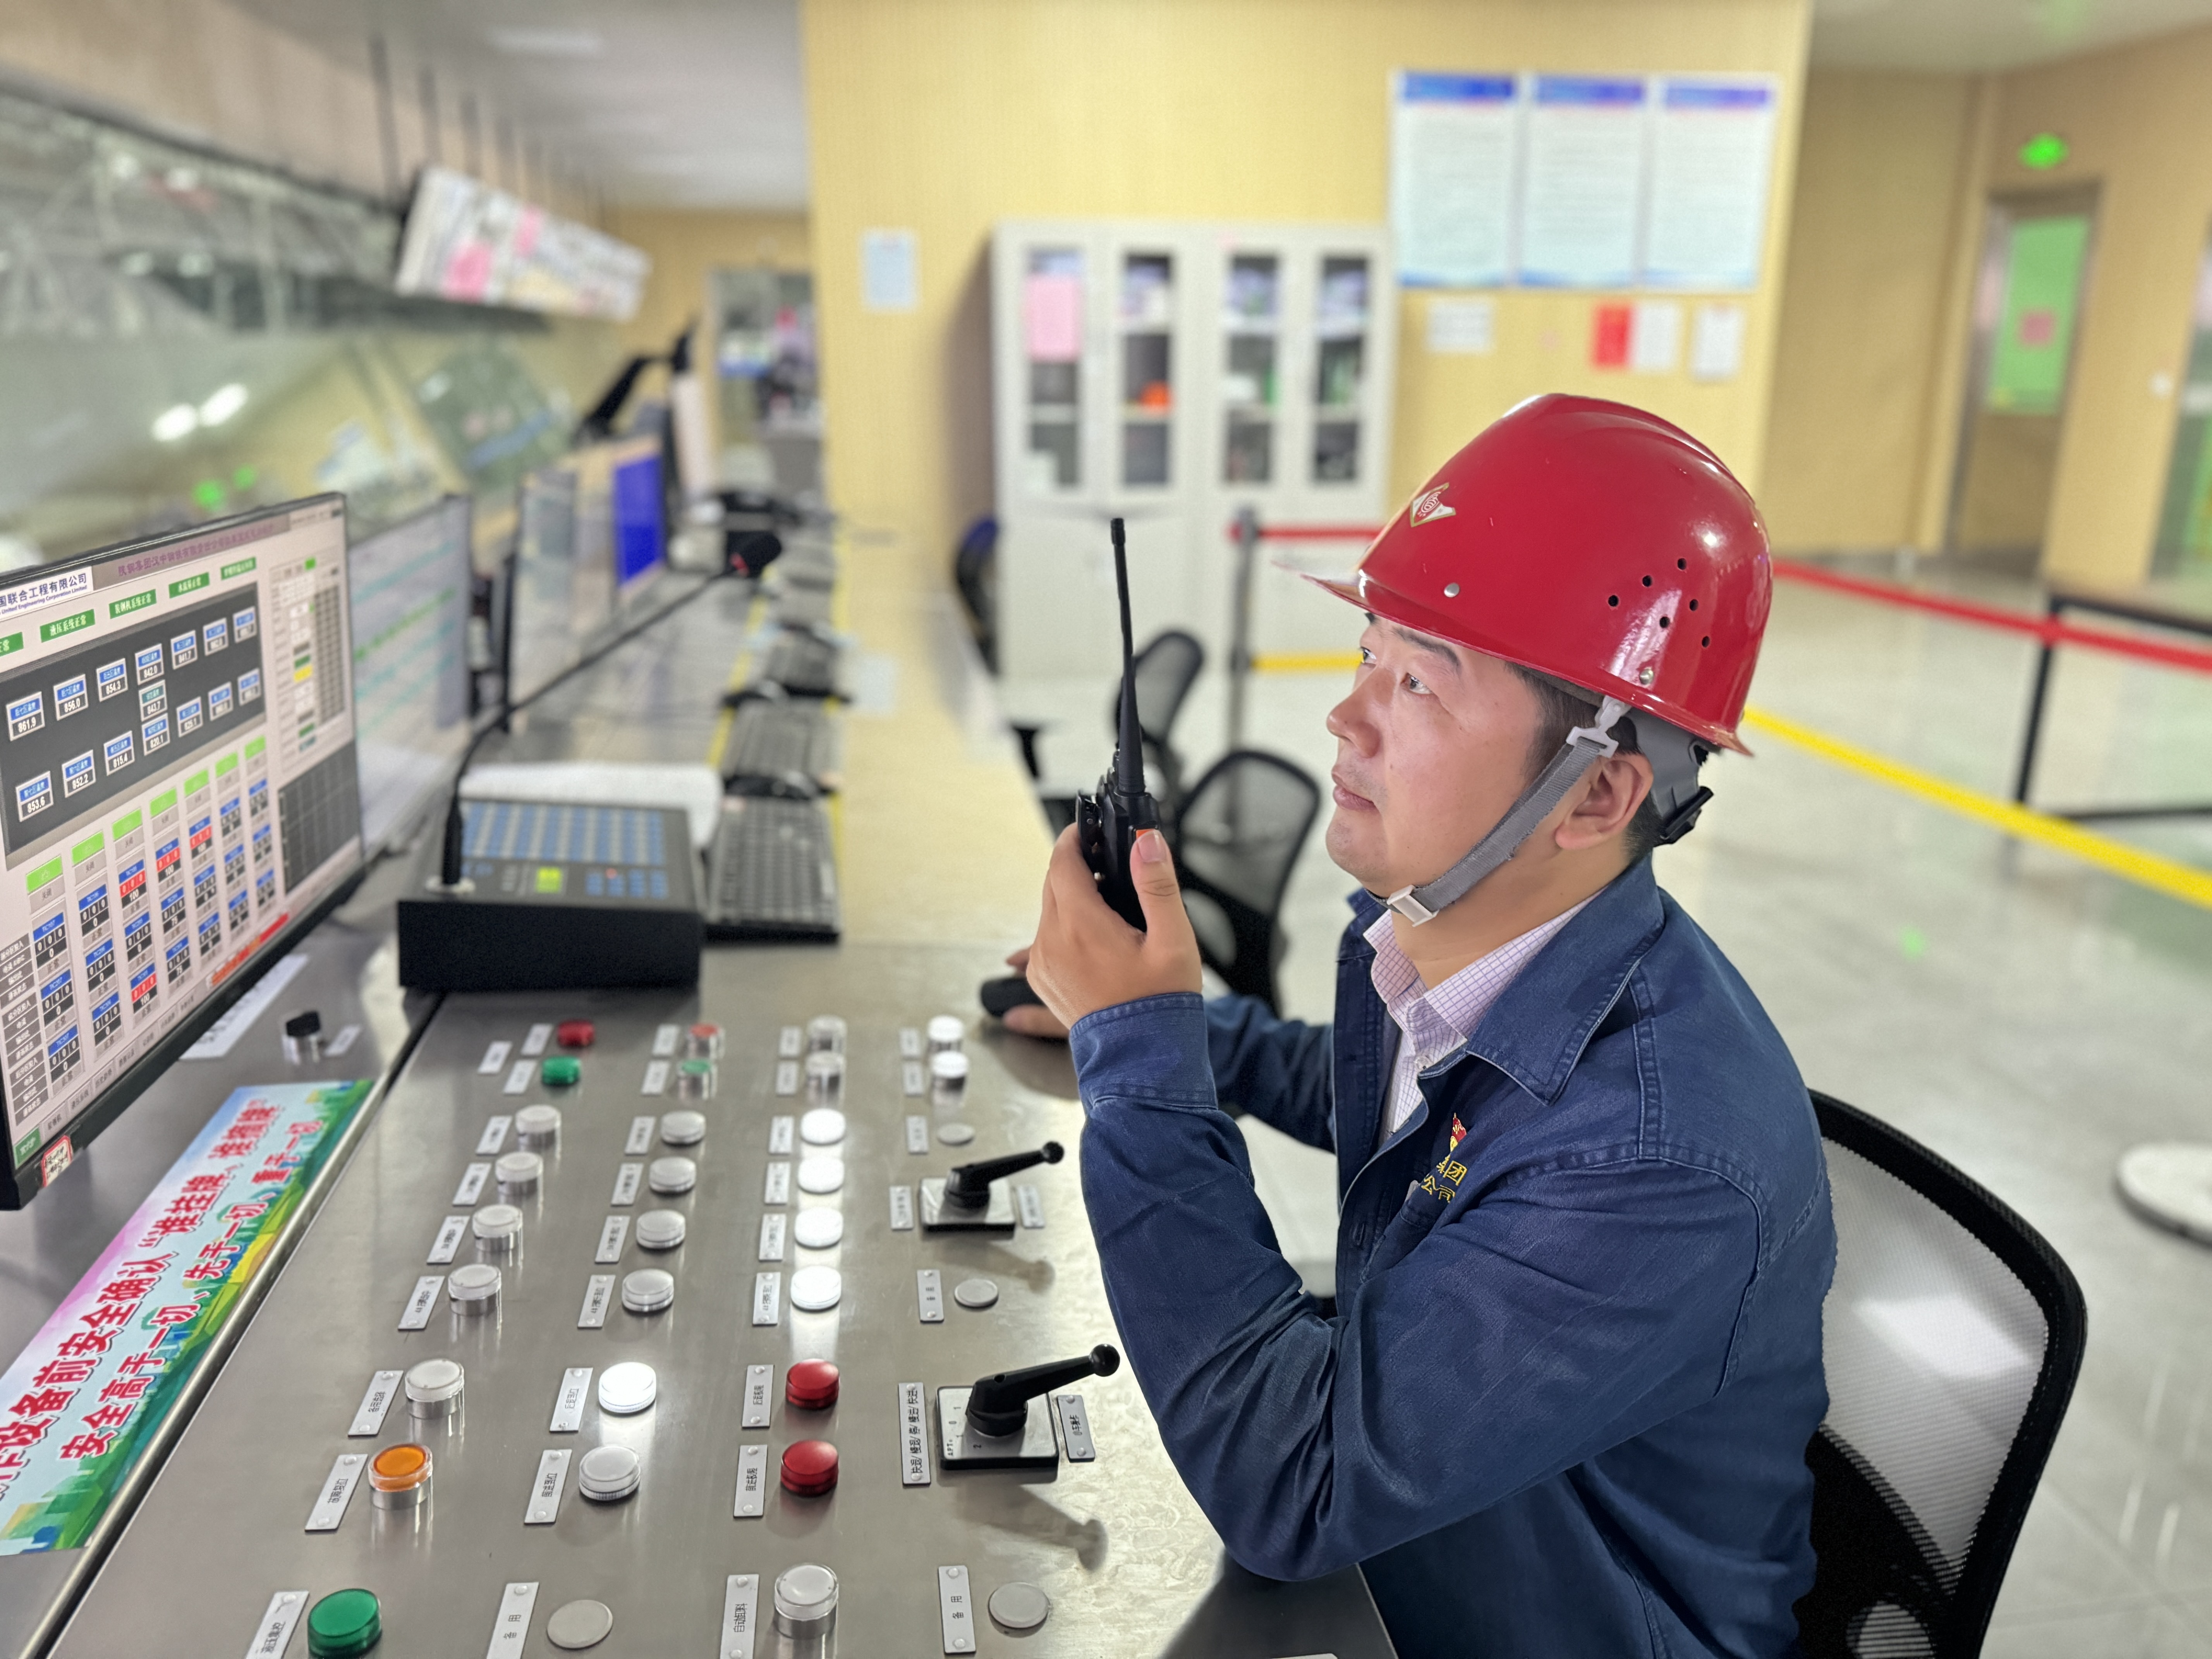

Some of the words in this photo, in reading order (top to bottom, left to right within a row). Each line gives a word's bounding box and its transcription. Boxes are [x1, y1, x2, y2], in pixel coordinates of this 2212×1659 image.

[0, 573, 86, 607] 国联合工程有限公司
[18, 597, 45, 610] Engineering
[46, 591, 71, 602] Corporation
[72, 584, 87, 594] Limited
[49, 614, 86, 636] 液压系统正常
[144, 665, 157, 679] 842.0
[106, 680, 121, 696] 854.3
[64, 698, 81, 714] 856.0
[18, 716, 36, 733] 861.9
[113, 752, 128, 769] 815.4
[72, 773, 89, 791] 852.2
[27, 794, 45, 815] 853.6
[165, 863, 174, 878] 100
[129, 887, 139, 903] 100
[93, 916, 98, 928] 0
[171, 914, 178, 927] 75
[49, 946, 54, 959] 0
[137, 942, 142, 954] 0
[99, 971, 104, 984] 0
[176, 964, 183, 977] 75
[140, 991, 150, 1008] 100
[56, 1004, 61, 1017] 0
[105, 1024, 110, 1037] 0
[63, 1059, 68, 1073] 0
[1421, 1175, 1456, 1203] 公司
[60, 1120, 323, 1460] 安全高于一切、先于一切、重于一切
[565, 1388, 579, 1410] 后退到位
[541, 1472, 558, 1498] 前进到位
[951, 1595, 964, 1620] 备用
[503, 1614, 521, 1640] 备用
